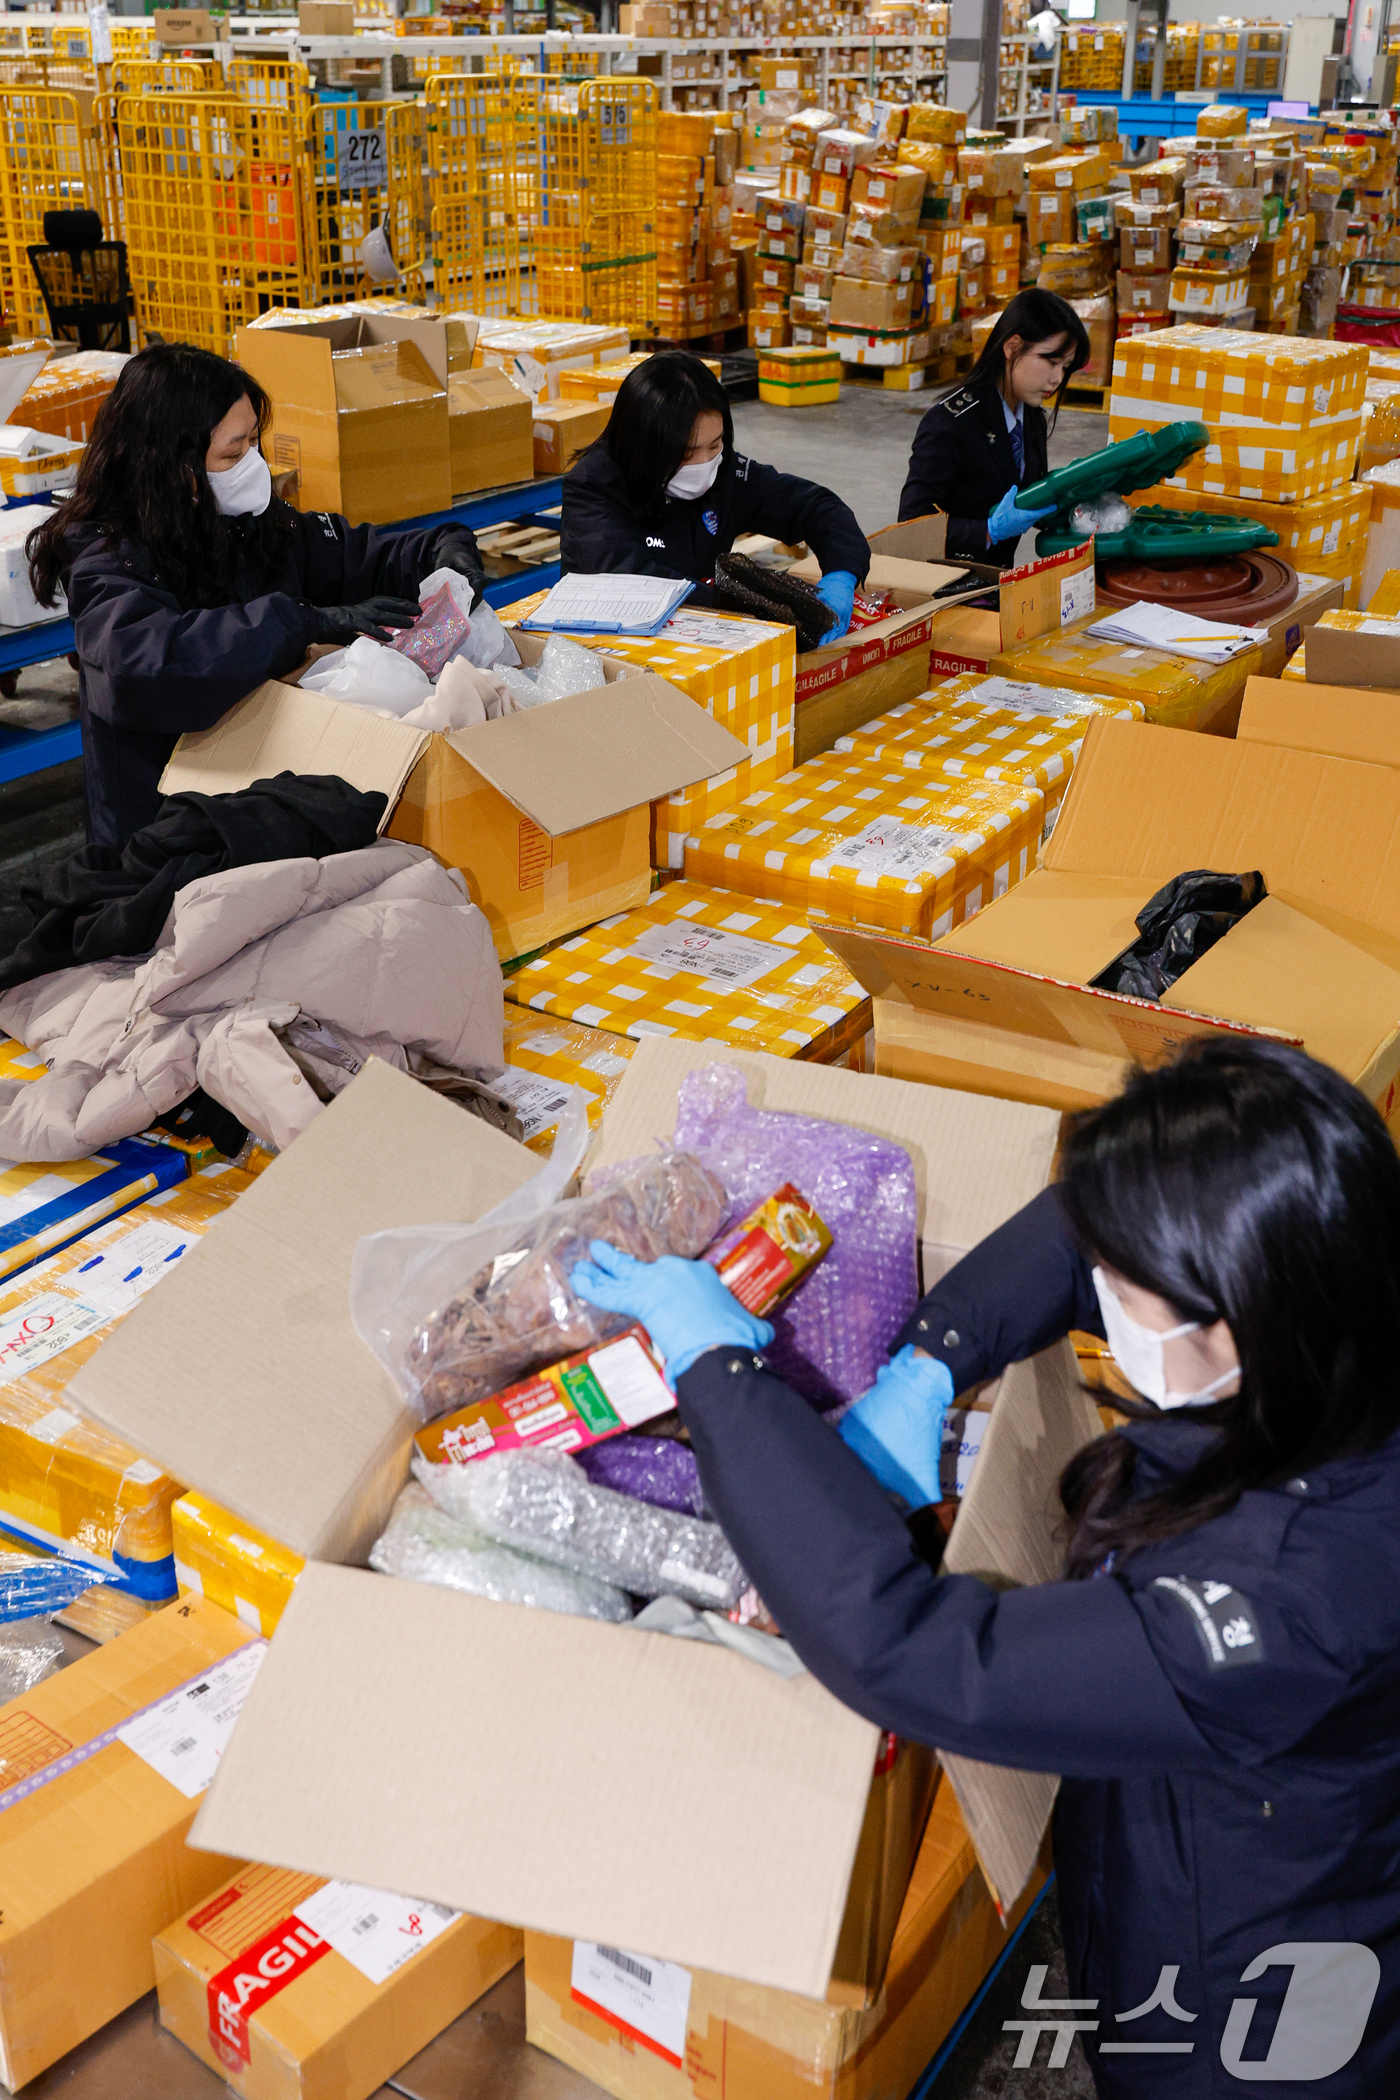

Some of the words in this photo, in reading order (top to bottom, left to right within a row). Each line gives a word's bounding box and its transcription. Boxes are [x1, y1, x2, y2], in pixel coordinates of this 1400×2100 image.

[348, 134, 380, 161] 272
[892, 627, 922, 651] FRAGILE
[930, 658, 978, 673] RAGILE
